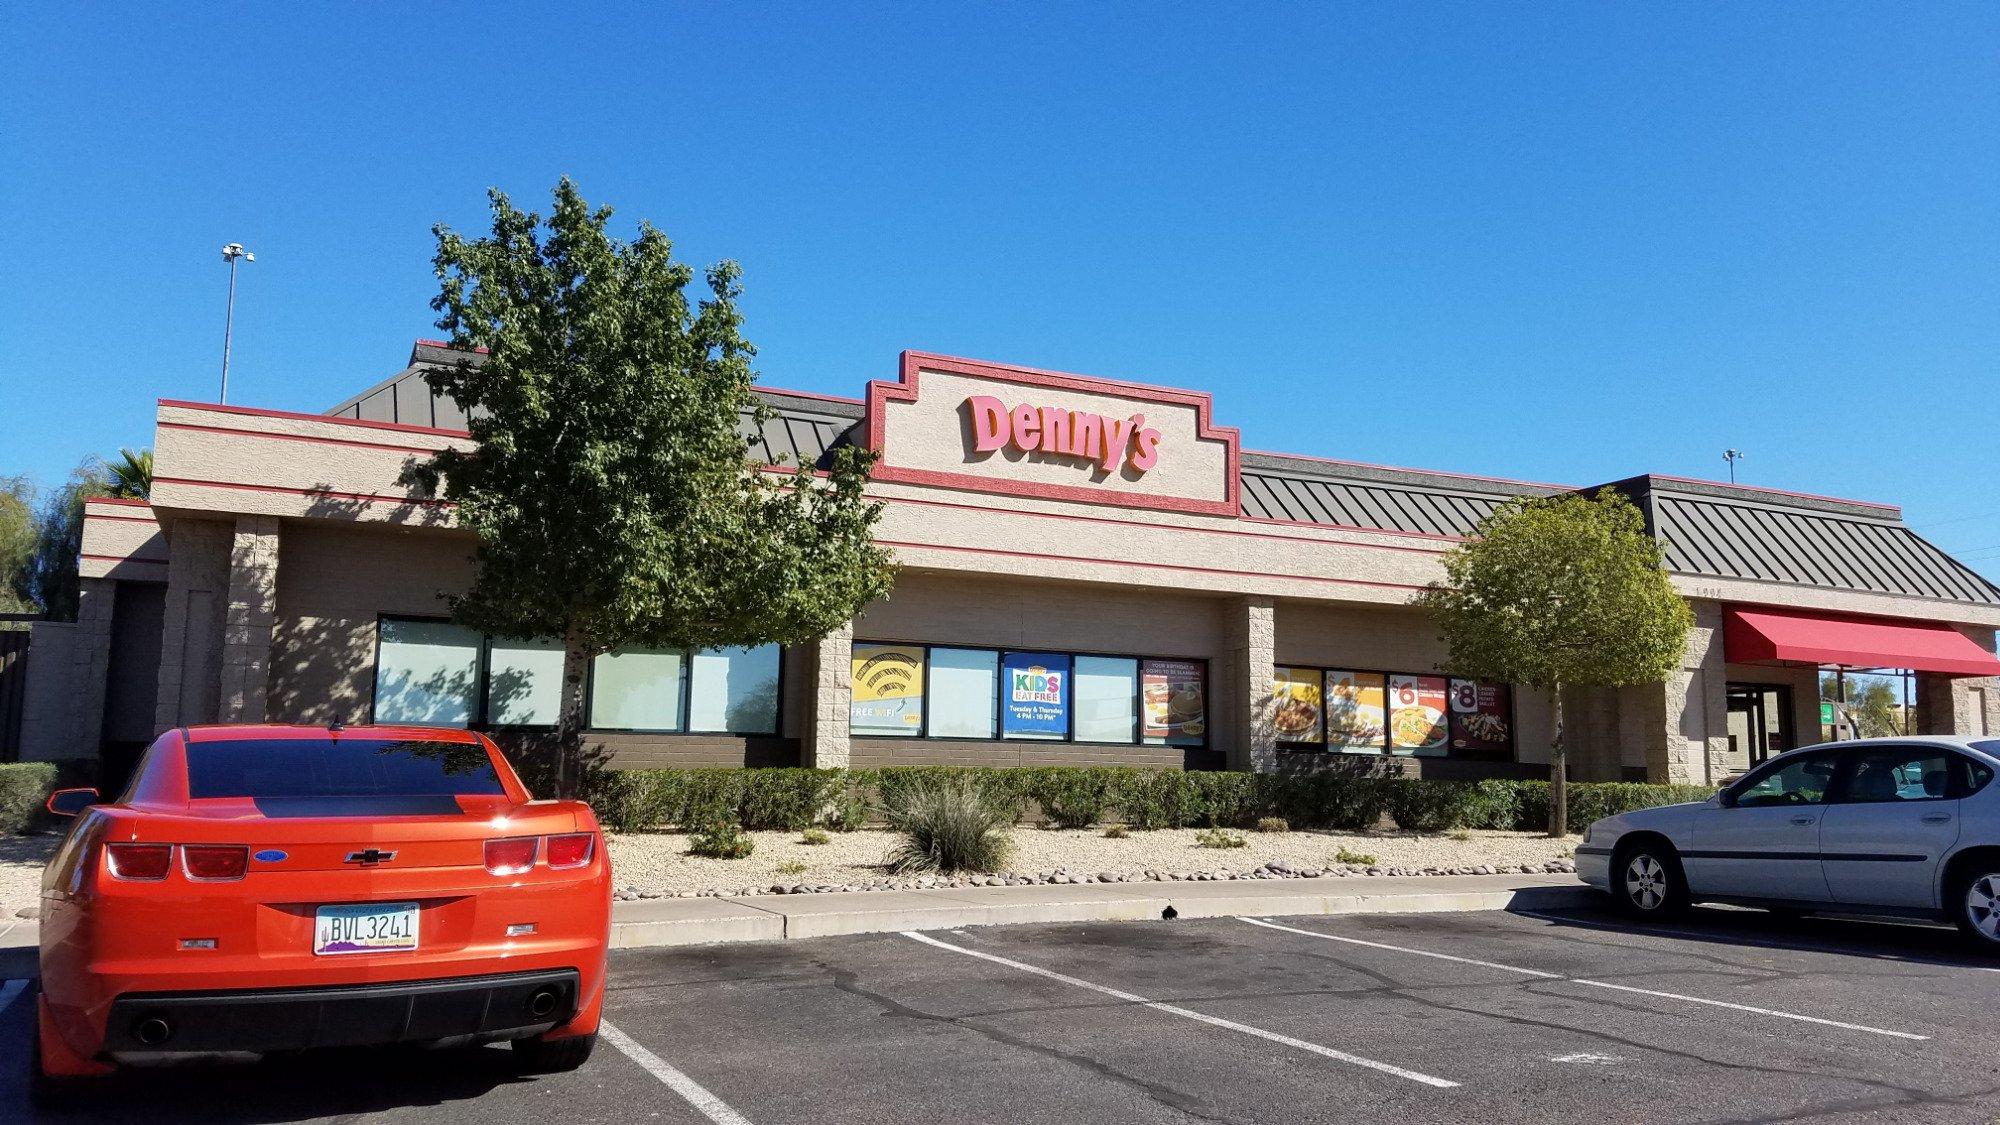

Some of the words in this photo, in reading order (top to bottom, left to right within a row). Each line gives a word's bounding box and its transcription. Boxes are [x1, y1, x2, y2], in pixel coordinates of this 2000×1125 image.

[967, 395, 1162, 472] Denny's
[1015, 674, 1059, 693] KIDS
[1392, 680, 1415, 705] $6
[1016, 691, 1033, 701] EAT
[1034, 692, 1058, 702] FREE
[1452, 683, 1476, 708] $8
[851, 707, 873, 717] FREE
[1010, 705, 1032, 713] Tuesday
[1038, 706, 1063, 715] Thursday
[331, 915, 412, 941] BVL3241
